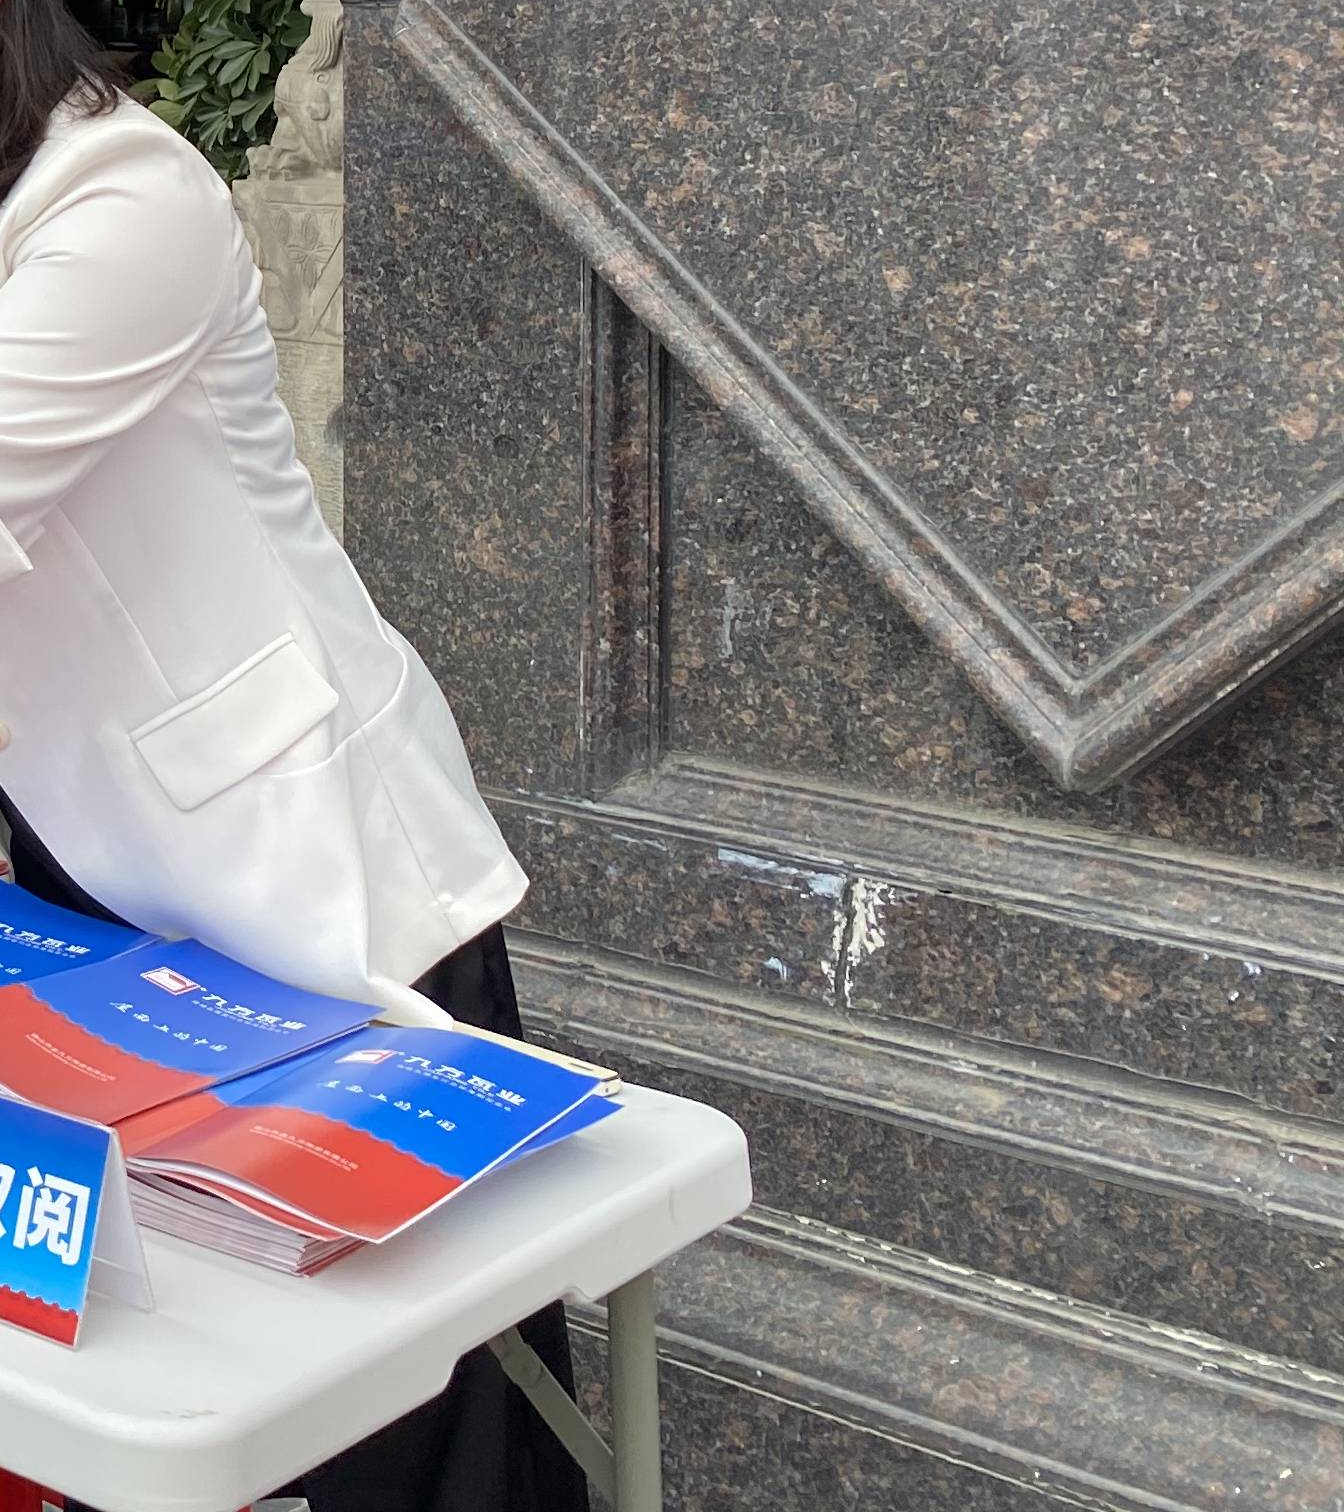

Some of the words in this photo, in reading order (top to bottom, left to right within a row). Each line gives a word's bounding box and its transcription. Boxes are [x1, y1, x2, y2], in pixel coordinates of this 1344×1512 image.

[202, 993, 307, 1031] 九方瓦业
[404, 1054, 526, 1107] 九方瓦业
